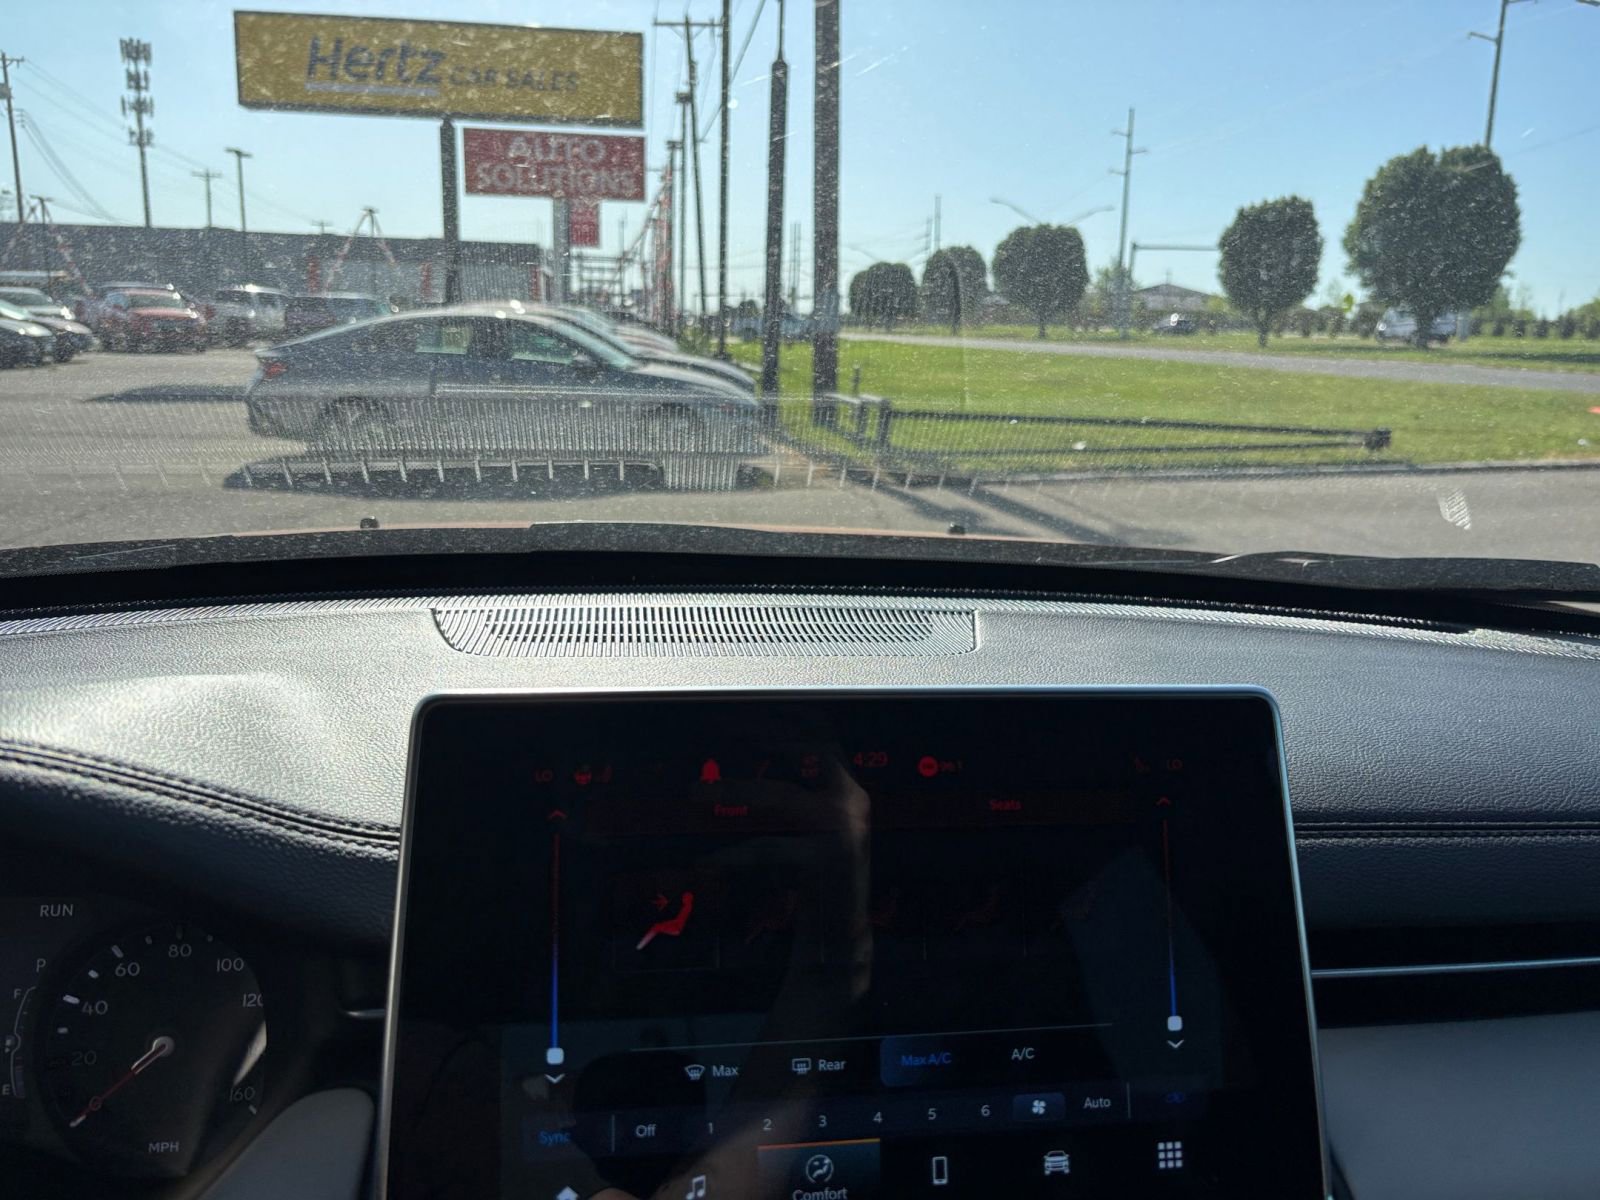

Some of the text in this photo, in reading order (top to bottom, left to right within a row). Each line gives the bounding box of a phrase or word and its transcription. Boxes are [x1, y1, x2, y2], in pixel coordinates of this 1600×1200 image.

[306, 34, 579, 92] Hertz CAR SALES
[507, 135, 606, 164] AUTO
[475, 161, 634, 194] SOLUTIONS
[713, 802, 750, 817] Front
[989, 799, 1022, 812] Seats
[39, 902, 75, 919] RUN
[167, 942, 193, 959] 80
[35, 957, 47, 973] P
[113, 961, 141, 978] 60
[215, 956, 245, 973] 100
[13, 987, 22, 1000] F
[81, 999, 109, 1016] 40
[71, 1050, 98, 1066] 20
[1010, 1046, 1037, 1062] A/C
[712, 1063, 739, 1078] Max
[817, 1057, 848, 1073] Rear
[1, 1083, 12, 1096] E
[229, 1086, 256, 1102] 160
[1082, 1095, 1112, 1110] Auto
[707, 1103, 991, 1135] 1 2 3 4 5 6
[538, 1129, 572, 1148] Sync
[635, 1123, 658, 1139] Off
[147, 1140, 180, 1154] MPH
[792, 1186, 848, 1200] Comfort
